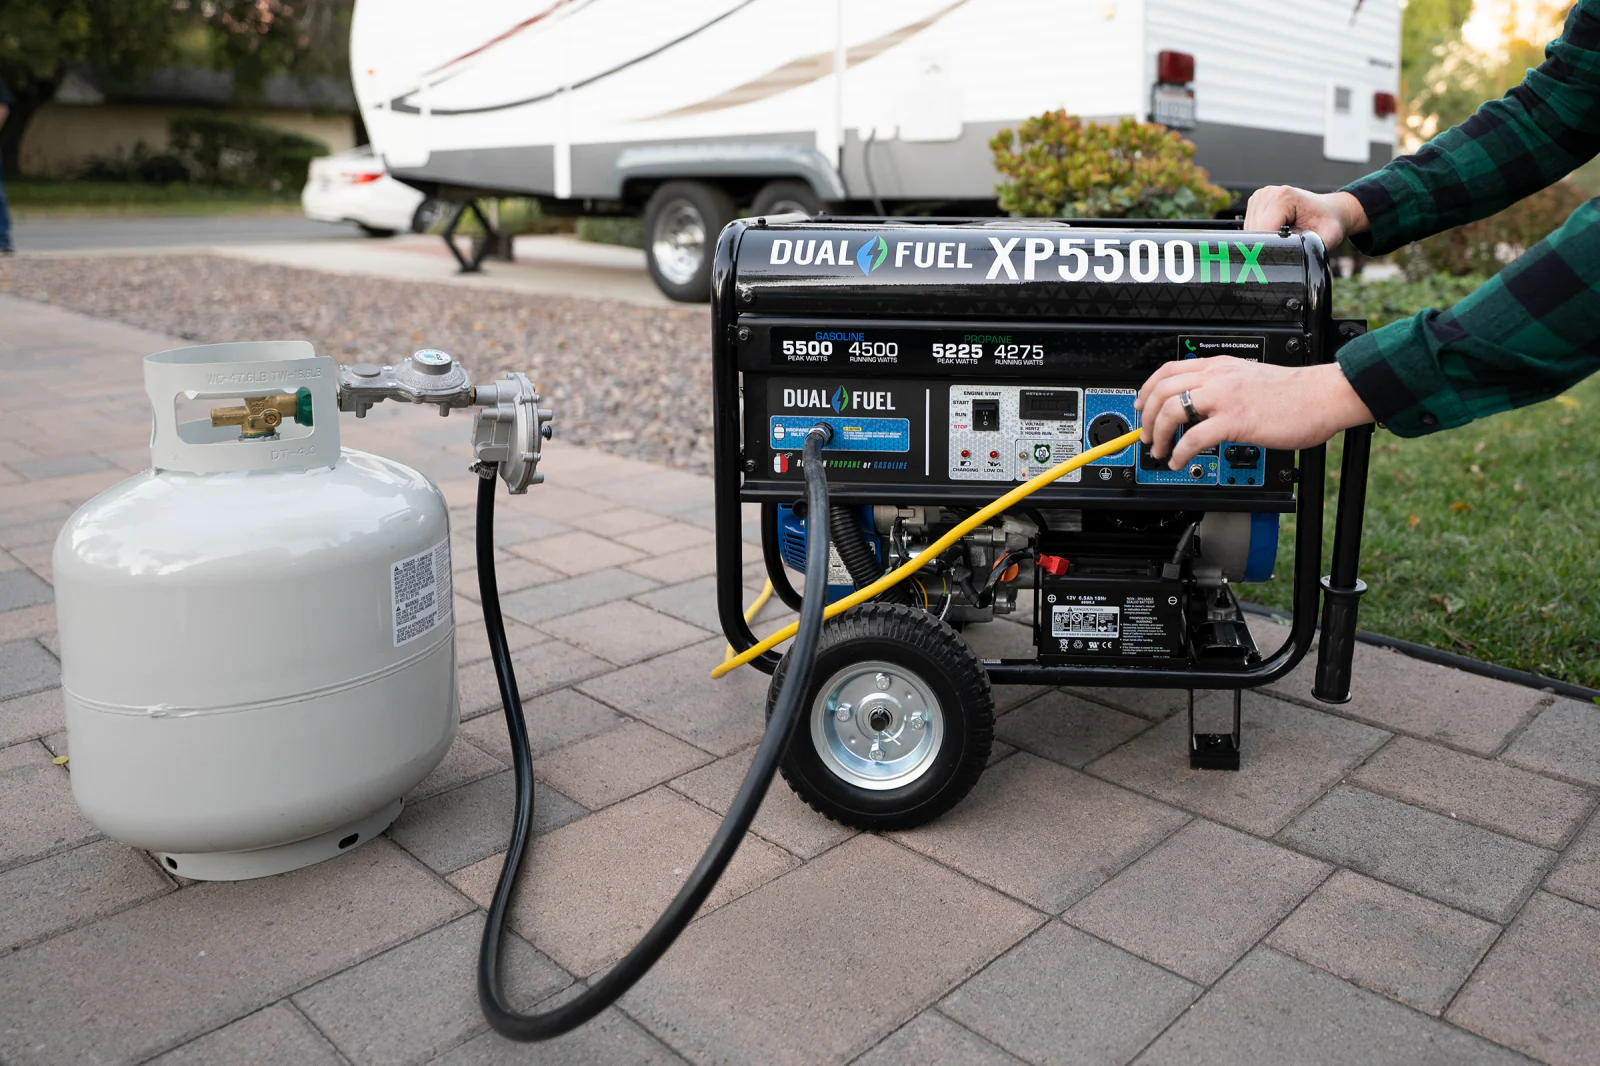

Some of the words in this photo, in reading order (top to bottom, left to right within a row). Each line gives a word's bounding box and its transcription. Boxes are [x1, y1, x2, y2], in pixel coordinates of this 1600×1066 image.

[769, 239, 854, 266] DUAL
[895, 241, 973, 269] FUEL
[985, 237, 1269, 285] XP5500HX
[815, 331, 865, 342] GASOLINE
[964, 334, 1012, 344] PROPANE
[782, 340, 833, 356] 5500
[848, 342, 898, 357] 4500
[932, 343, 983, 359] 5225
[993, 344, 1044, 360] 4275
[877, 356, 898, 364] WATTS
[783, 388, 831, 408] DUAL
[852, 391, 896, 410] FUEL
[829, 460, 861, 469] PROPANE
[863, 461, 871, 469] or
[873, 461, 908, 470] GASOLINE
